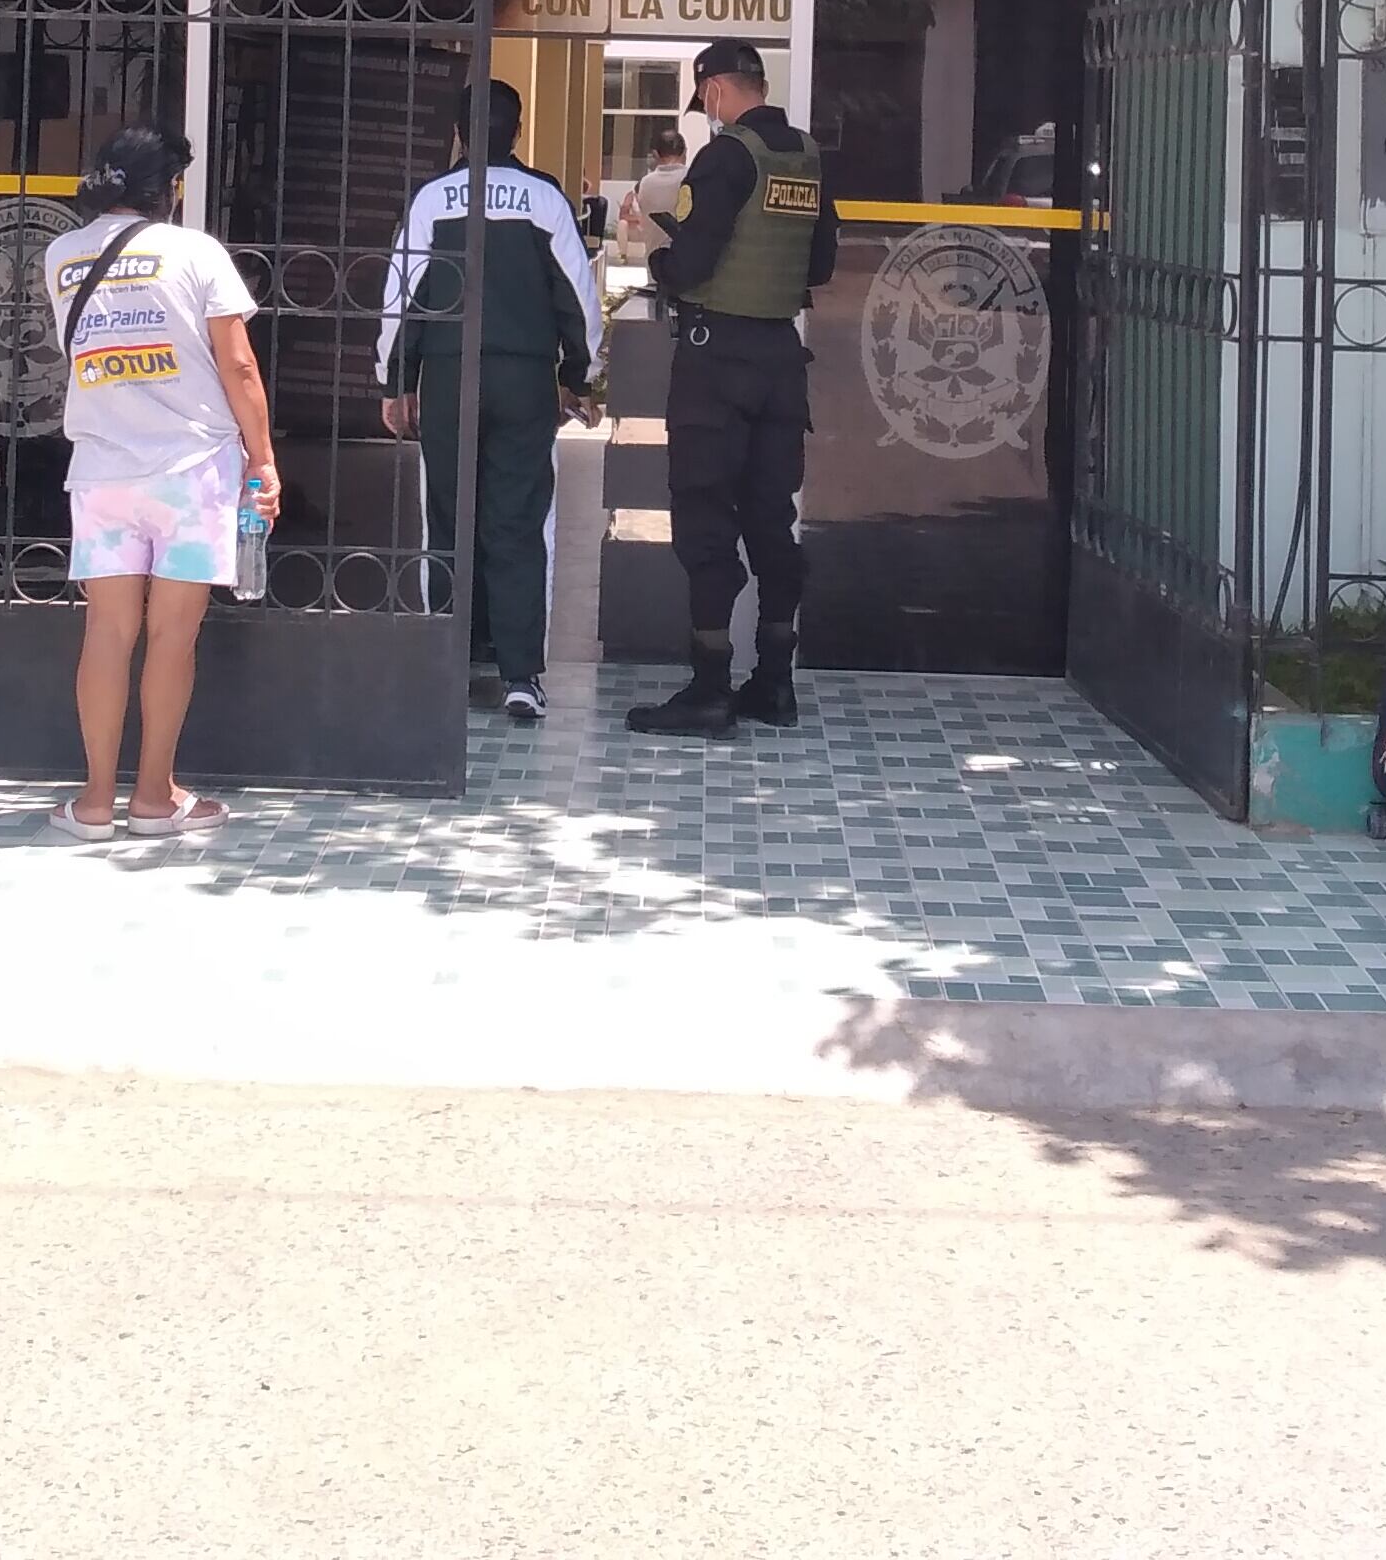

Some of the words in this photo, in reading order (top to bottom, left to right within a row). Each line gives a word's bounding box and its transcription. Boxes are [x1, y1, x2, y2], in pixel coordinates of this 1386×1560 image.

[443, 183, 532, 213] POICIA
[769, 183, 817, 209] POLICIA
[60, 256, 155, 287] Cersita
